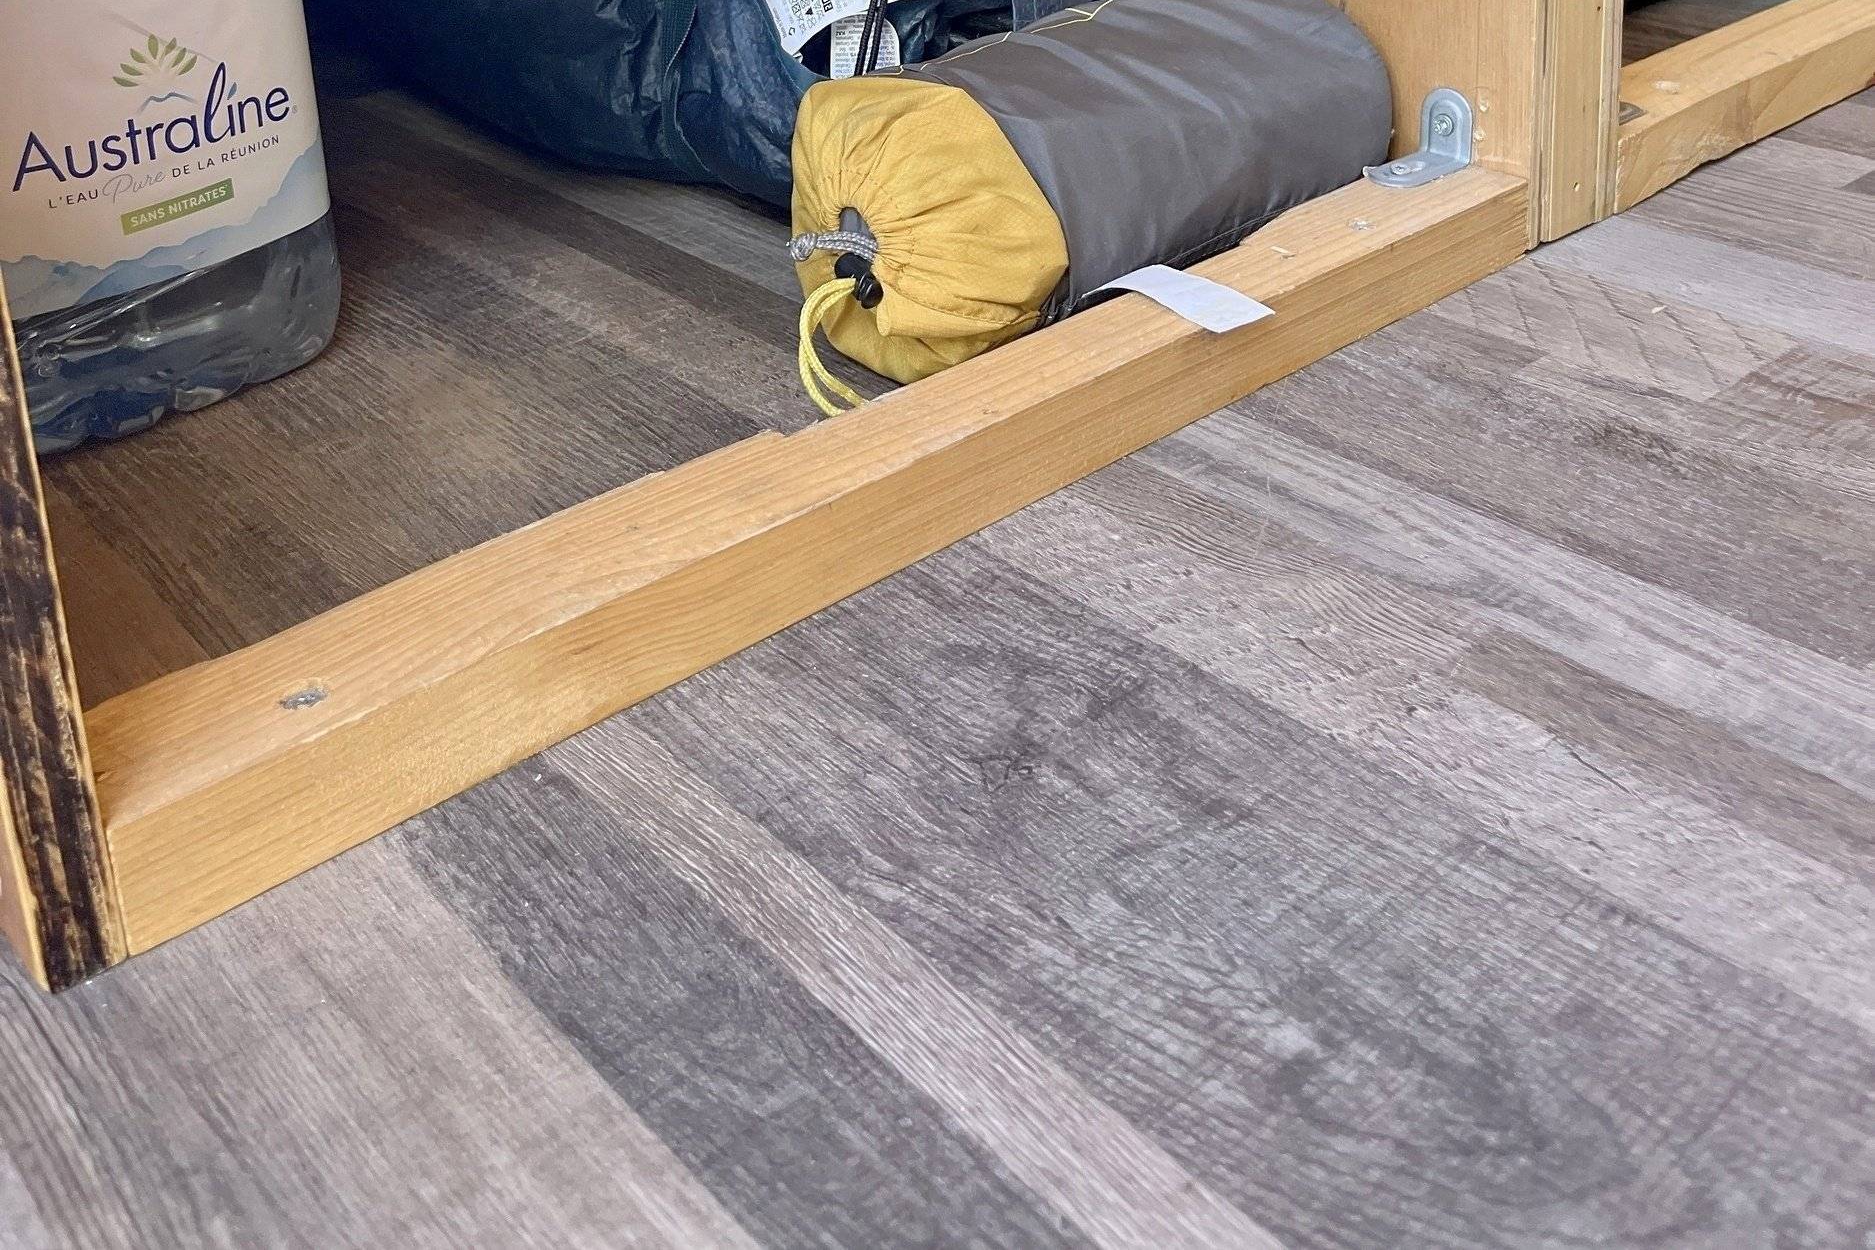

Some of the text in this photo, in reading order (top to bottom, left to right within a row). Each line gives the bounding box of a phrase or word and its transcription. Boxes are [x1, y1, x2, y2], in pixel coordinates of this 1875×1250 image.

[12, 61, 290, 192] Australine
[48, 135, 280, 209] L'EAU Pure DE LA RÉUNION
[130, 208, 165, 227] SANS
